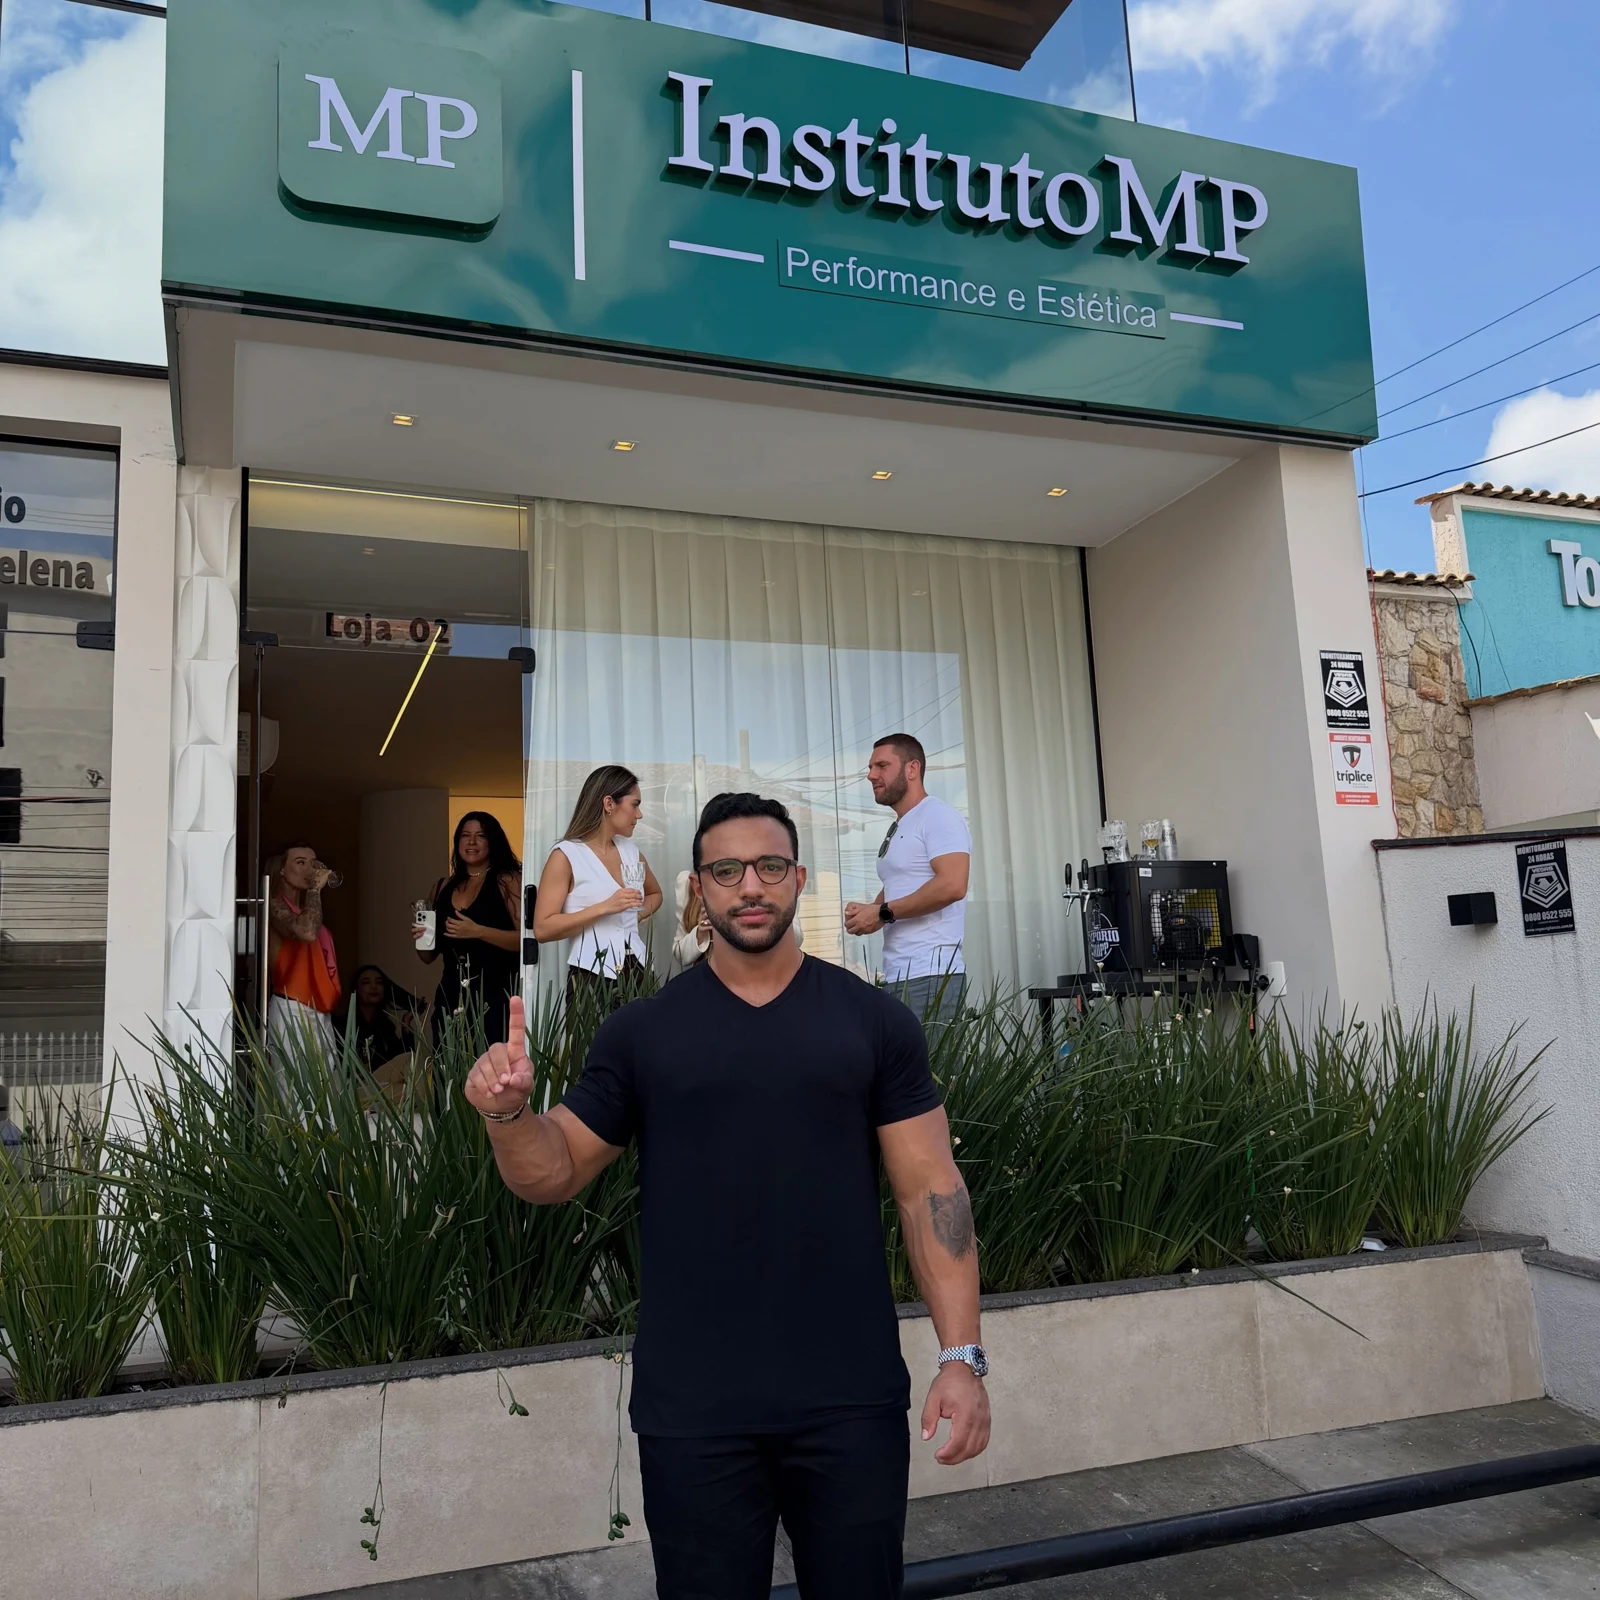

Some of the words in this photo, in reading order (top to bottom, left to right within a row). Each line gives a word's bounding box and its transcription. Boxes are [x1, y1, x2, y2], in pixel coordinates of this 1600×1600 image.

[305, 73, 478, 169] MP
[786, 246, 997, 308] Performance
[1007, 289, 1026, 312] e
[1037, 285, 1158, 330] Estética
[326, 612, 392, 647] Loja
[410, 618, 449, 644] 02
[1327, 709, 1341, 717] 0800
[1356, 710, 1368, 718] 555
[1516, 840, 1565, 855] MONITORAMENTO
[1527, 855, 1535, 864] 24
[1535, 852, 1554, 863] HORAS
[1524, 912, 1542, 922] 0800
[1541, 910, 1558, 921] 0522
[1558, 908, 1572, 919] 555
